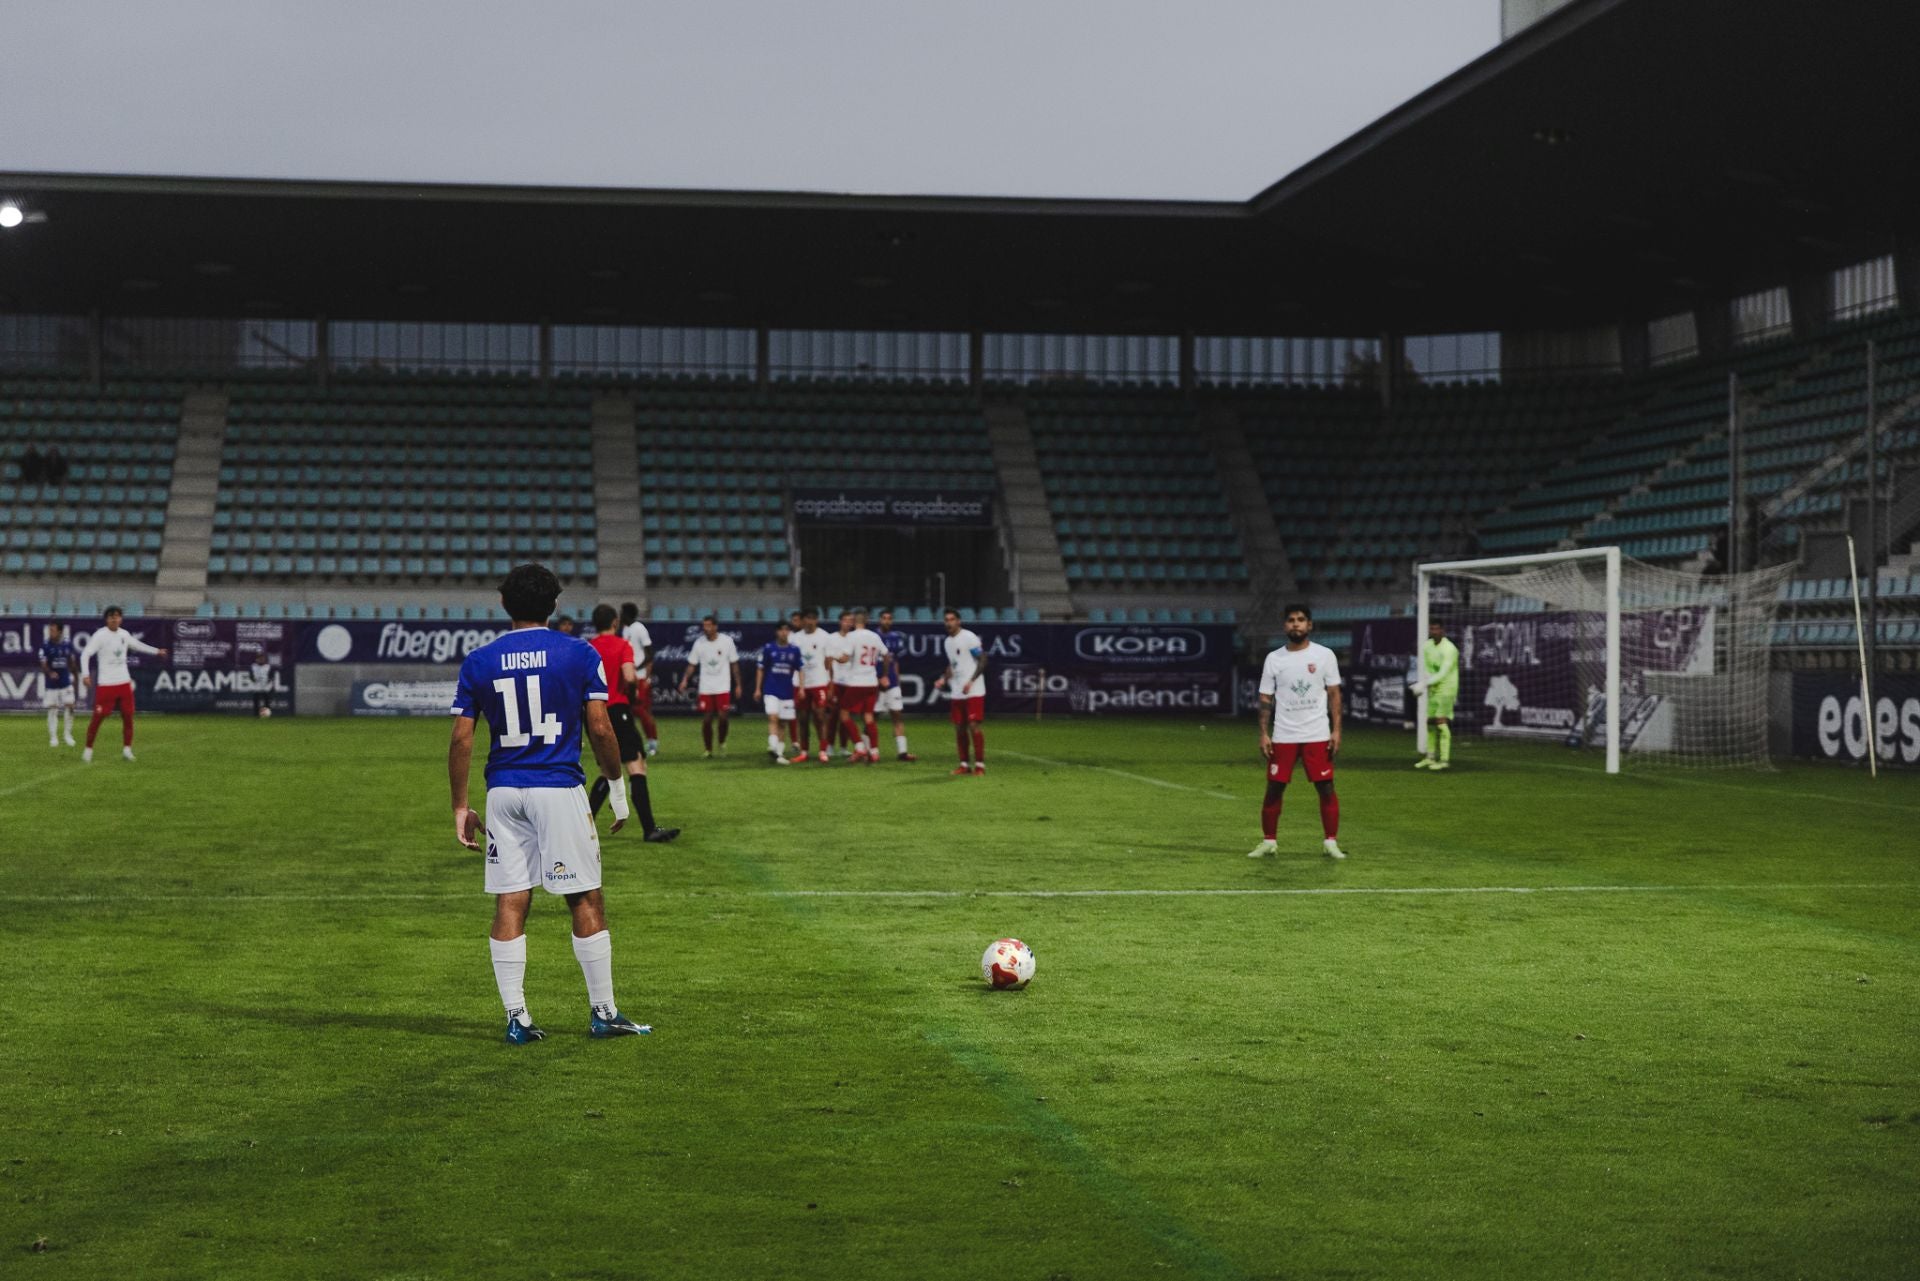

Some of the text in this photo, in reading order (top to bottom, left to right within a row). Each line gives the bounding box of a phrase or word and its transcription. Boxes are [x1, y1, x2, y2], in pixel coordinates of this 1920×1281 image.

[0, 623, 33, 653] al
[378, 623, 510, 662] fibergree
[1094, 635, 1186, 653] KOPA
[501, 651, 547, 670] LUISMI
[154, 670, 289, 692] ARAMBL
[493, 674, 562, 747] 14
[1088, 684, 1219, 712] palencia
